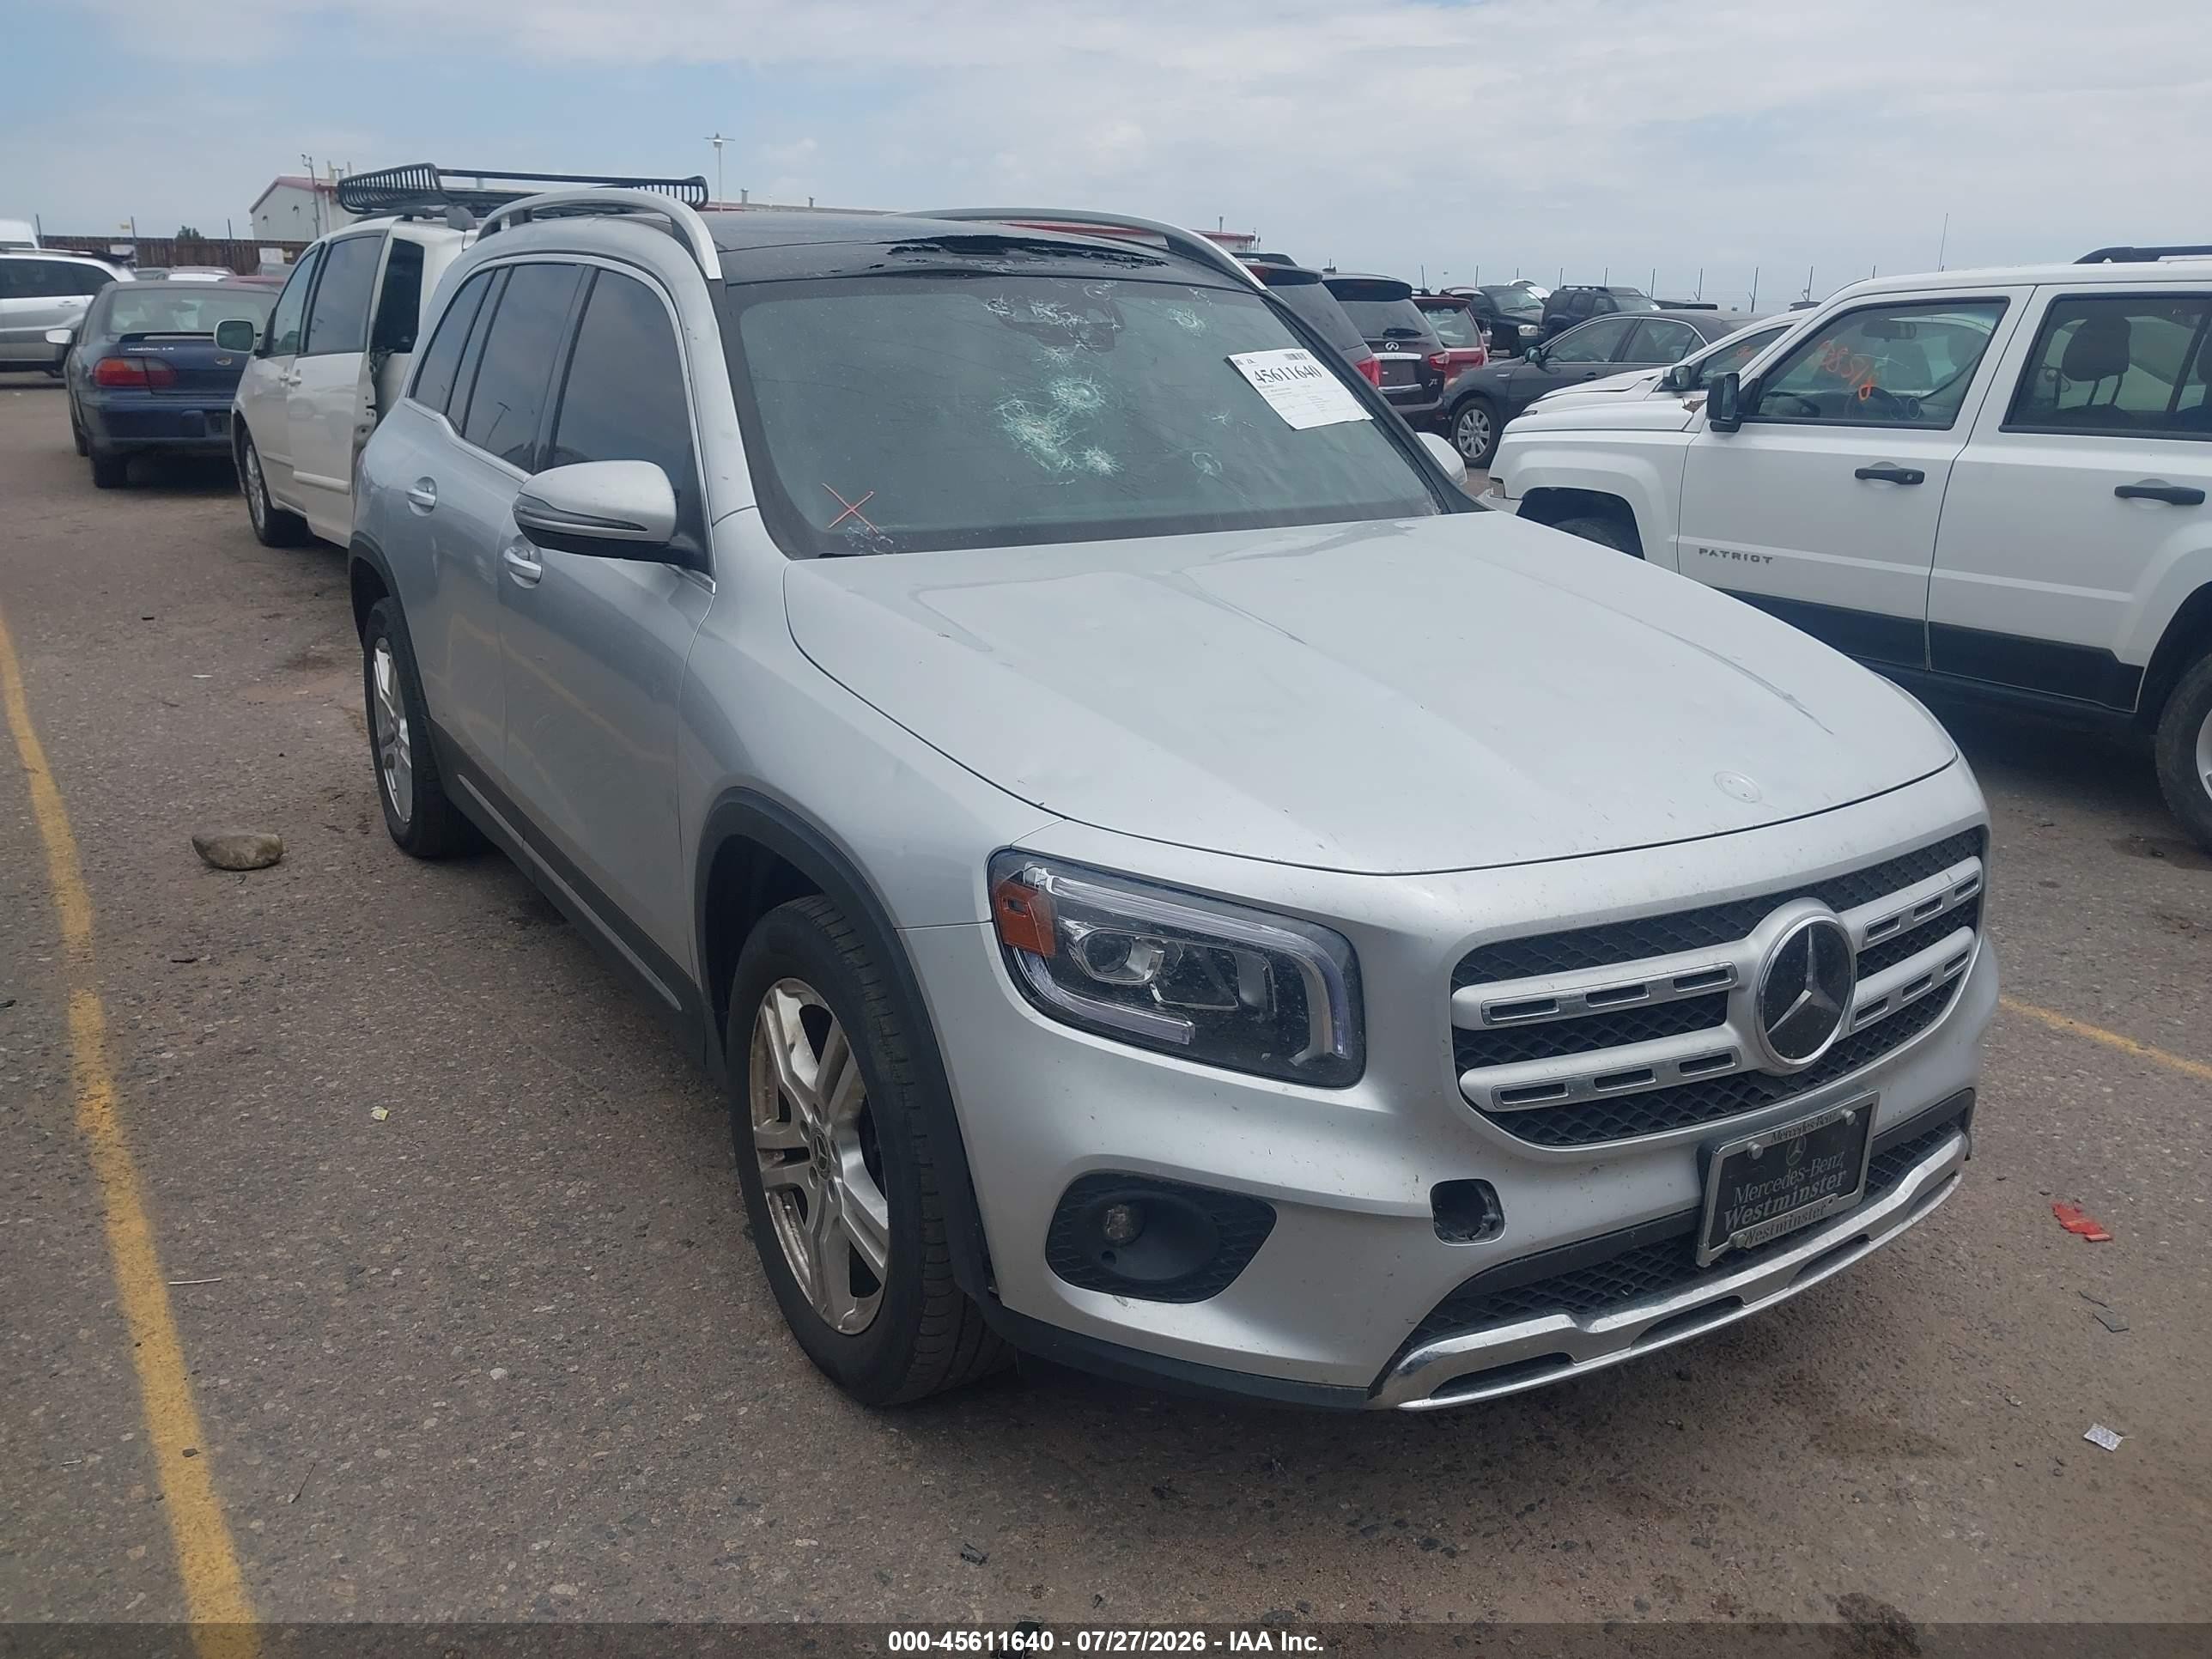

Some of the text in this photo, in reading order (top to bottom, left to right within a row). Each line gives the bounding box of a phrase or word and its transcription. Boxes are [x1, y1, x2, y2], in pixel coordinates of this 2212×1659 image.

[1254, 364, 1323, 384] 45611640
[1698, 548, 1773, 564] PATRIOT
[1733, 1151, 1845, 1206] Mercedes-Benz
[1724, 1170, 1847, 1231] Westminster
[1743, 1203, 1827, 1245] Westminster
